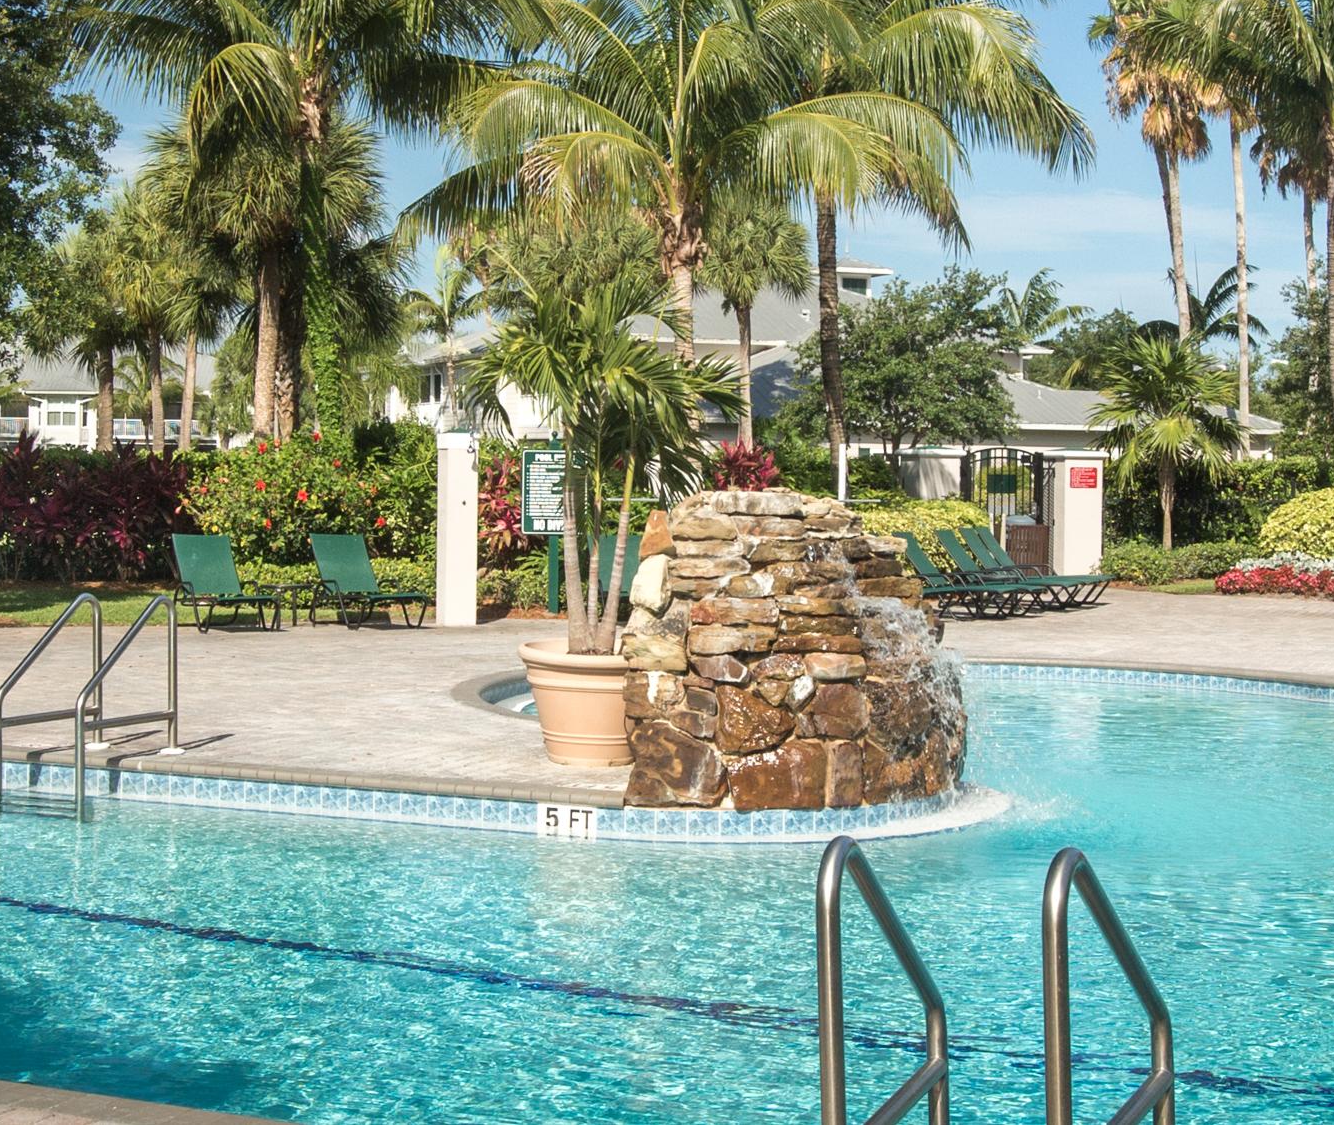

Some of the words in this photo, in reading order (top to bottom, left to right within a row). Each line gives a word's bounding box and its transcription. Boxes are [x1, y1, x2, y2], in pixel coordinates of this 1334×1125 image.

[533, 519, 545, 531] NO
[546, 807, 559, 828] 5
[569, 809, 593, 829] FT
